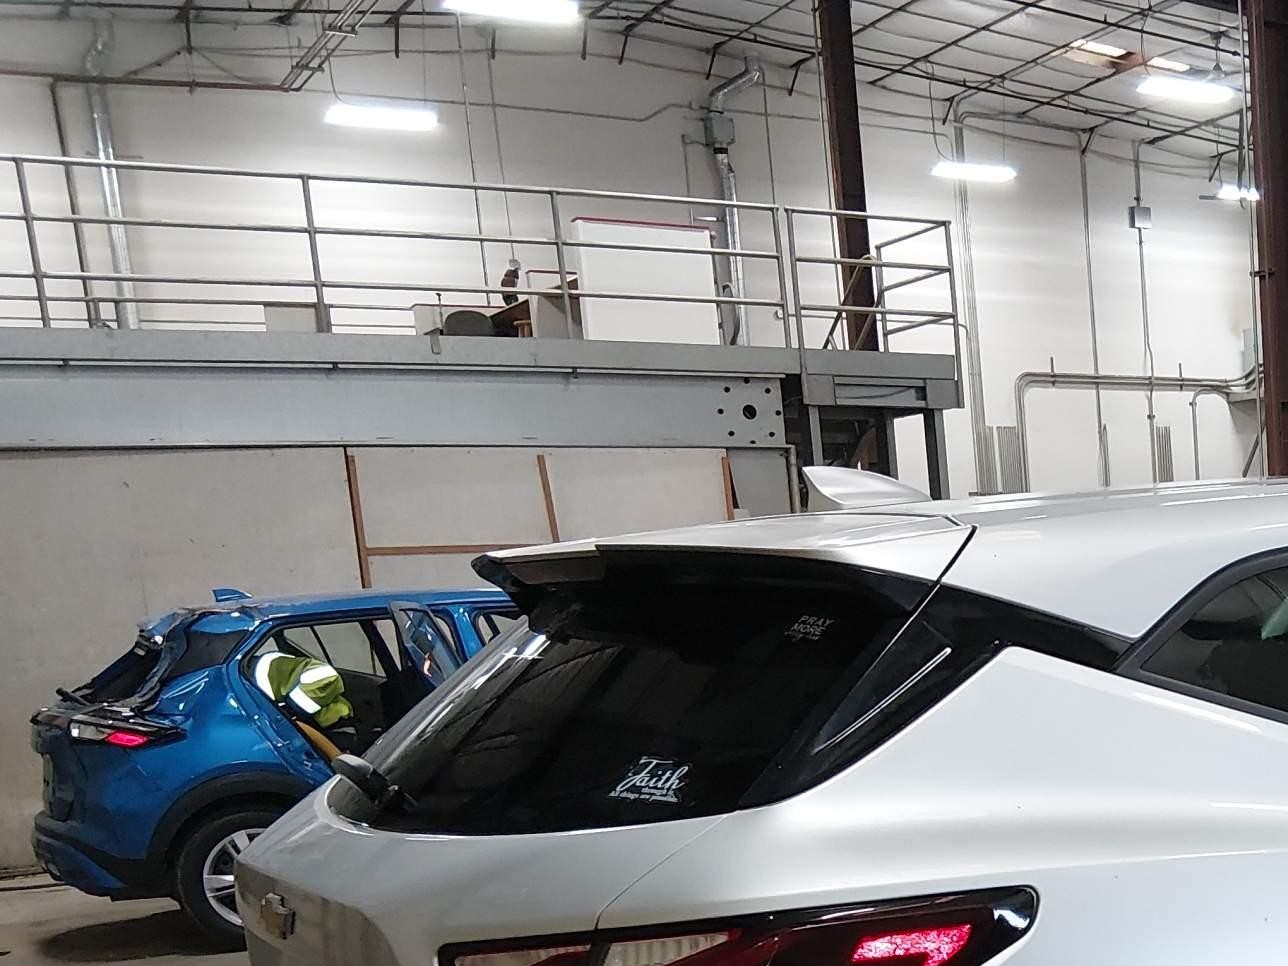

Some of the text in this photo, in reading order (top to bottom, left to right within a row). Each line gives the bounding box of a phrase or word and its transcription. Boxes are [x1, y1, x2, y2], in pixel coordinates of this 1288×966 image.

[798, 615, 835, 627] PRAY
[790, 622, 826, 635] MORE
[615, 758, 689, 792] Faith
